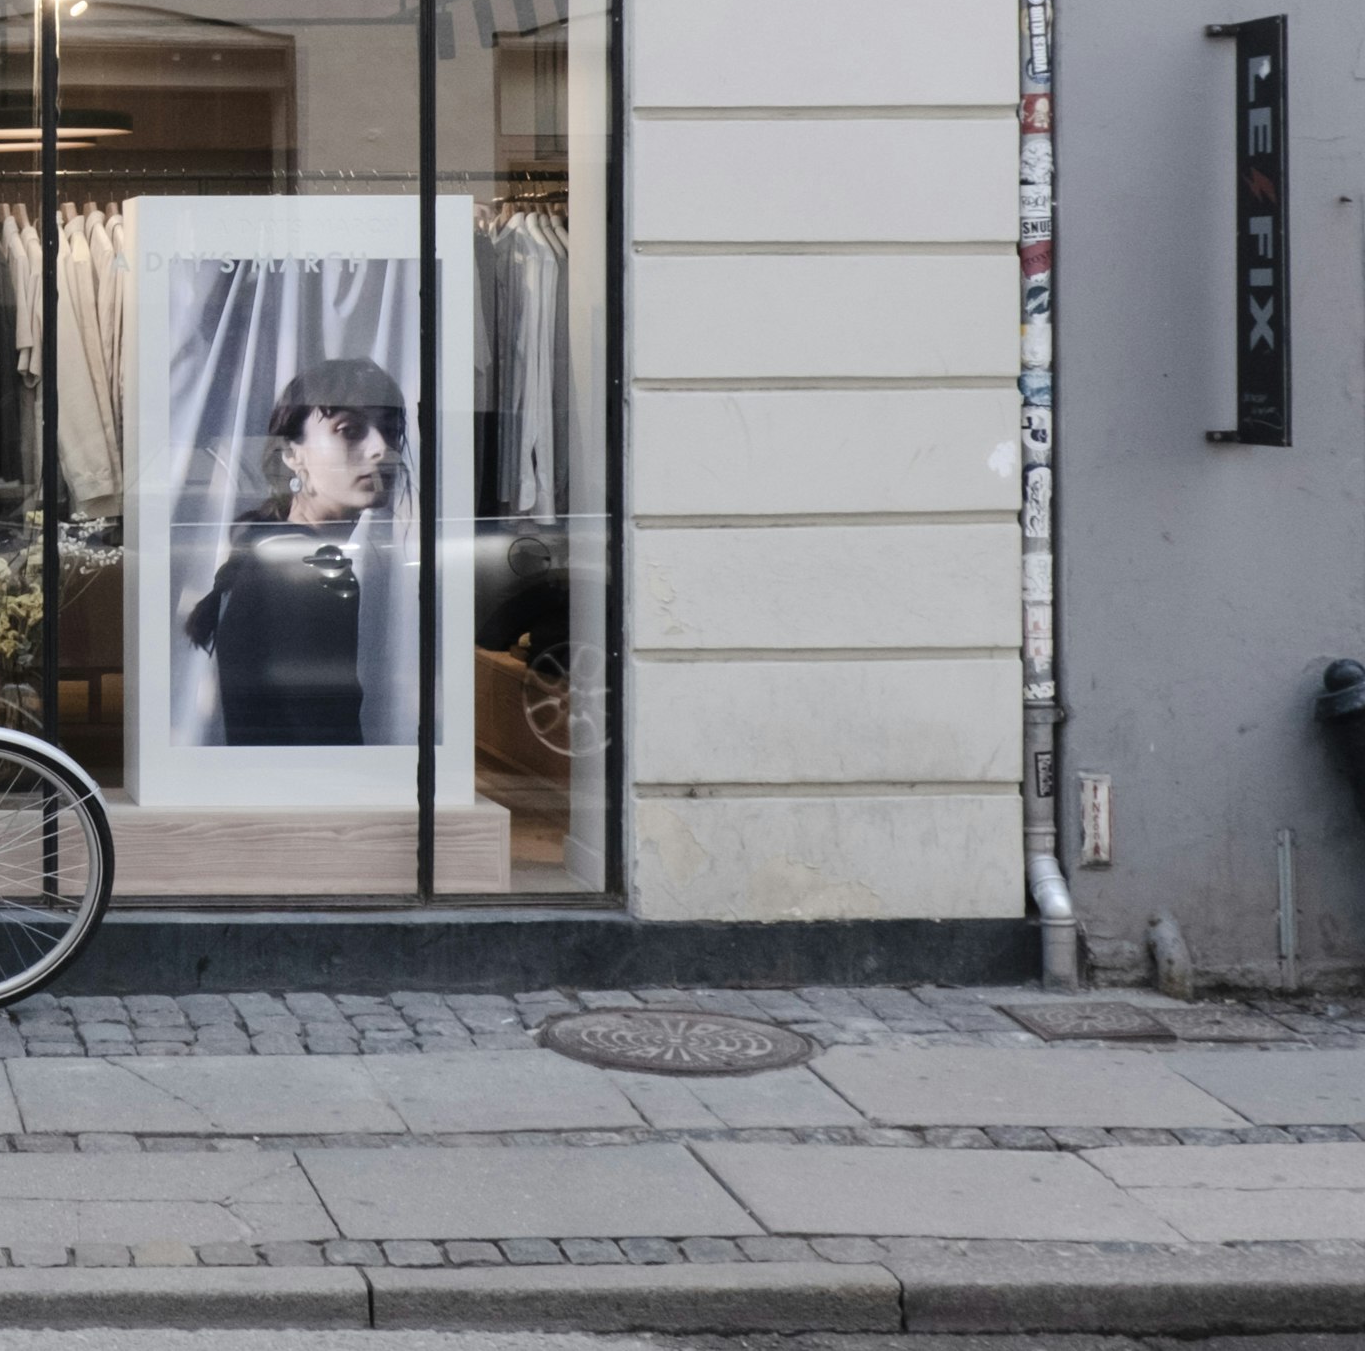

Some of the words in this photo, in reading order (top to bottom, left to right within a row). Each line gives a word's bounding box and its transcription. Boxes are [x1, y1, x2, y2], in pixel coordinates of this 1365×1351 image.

[1248, 54, 1272, 156] LE
[111, 252, 131, 273] A
[1248, 215, 1274, 351] FIX
